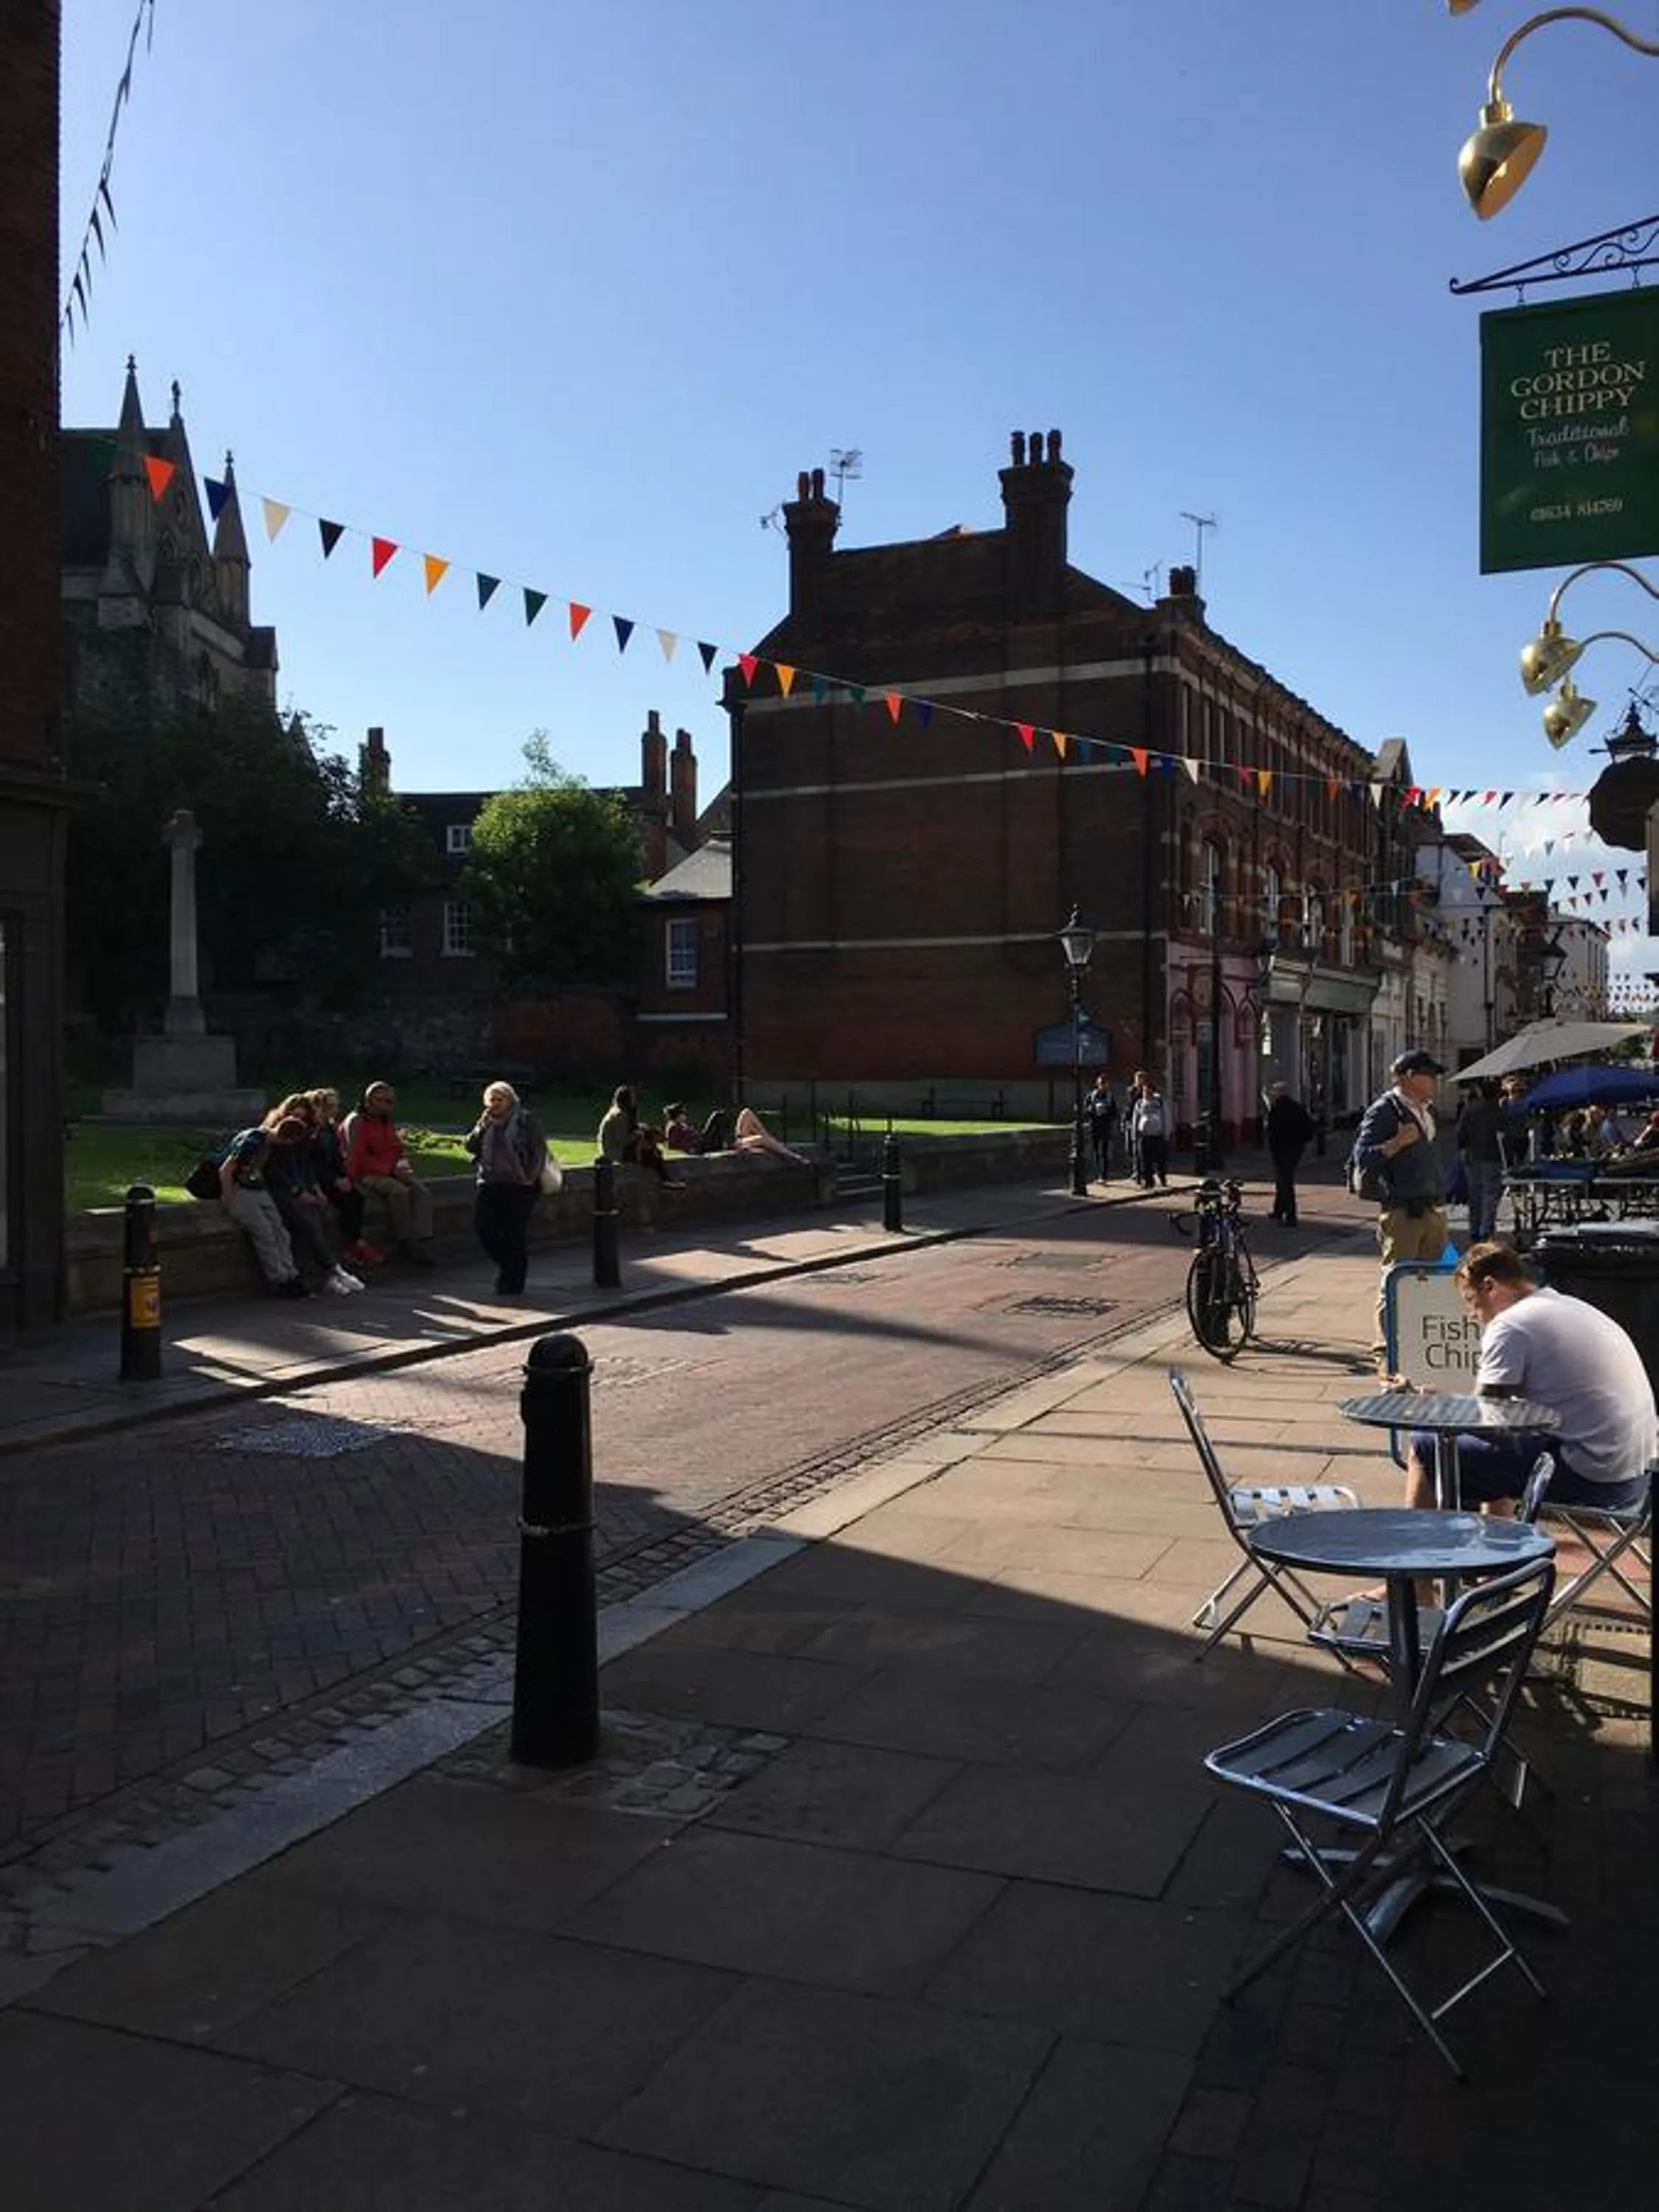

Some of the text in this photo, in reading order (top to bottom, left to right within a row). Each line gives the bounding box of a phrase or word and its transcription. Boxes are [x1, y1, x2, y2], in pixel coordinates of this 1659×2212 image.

[1545, 342, 1610, 368] THE
[1511, 361, 1645, 397] GORDON
[1520, 386, 1635, 420] CHIPPY
[1422, 1315, 1480, 1340] Fish
